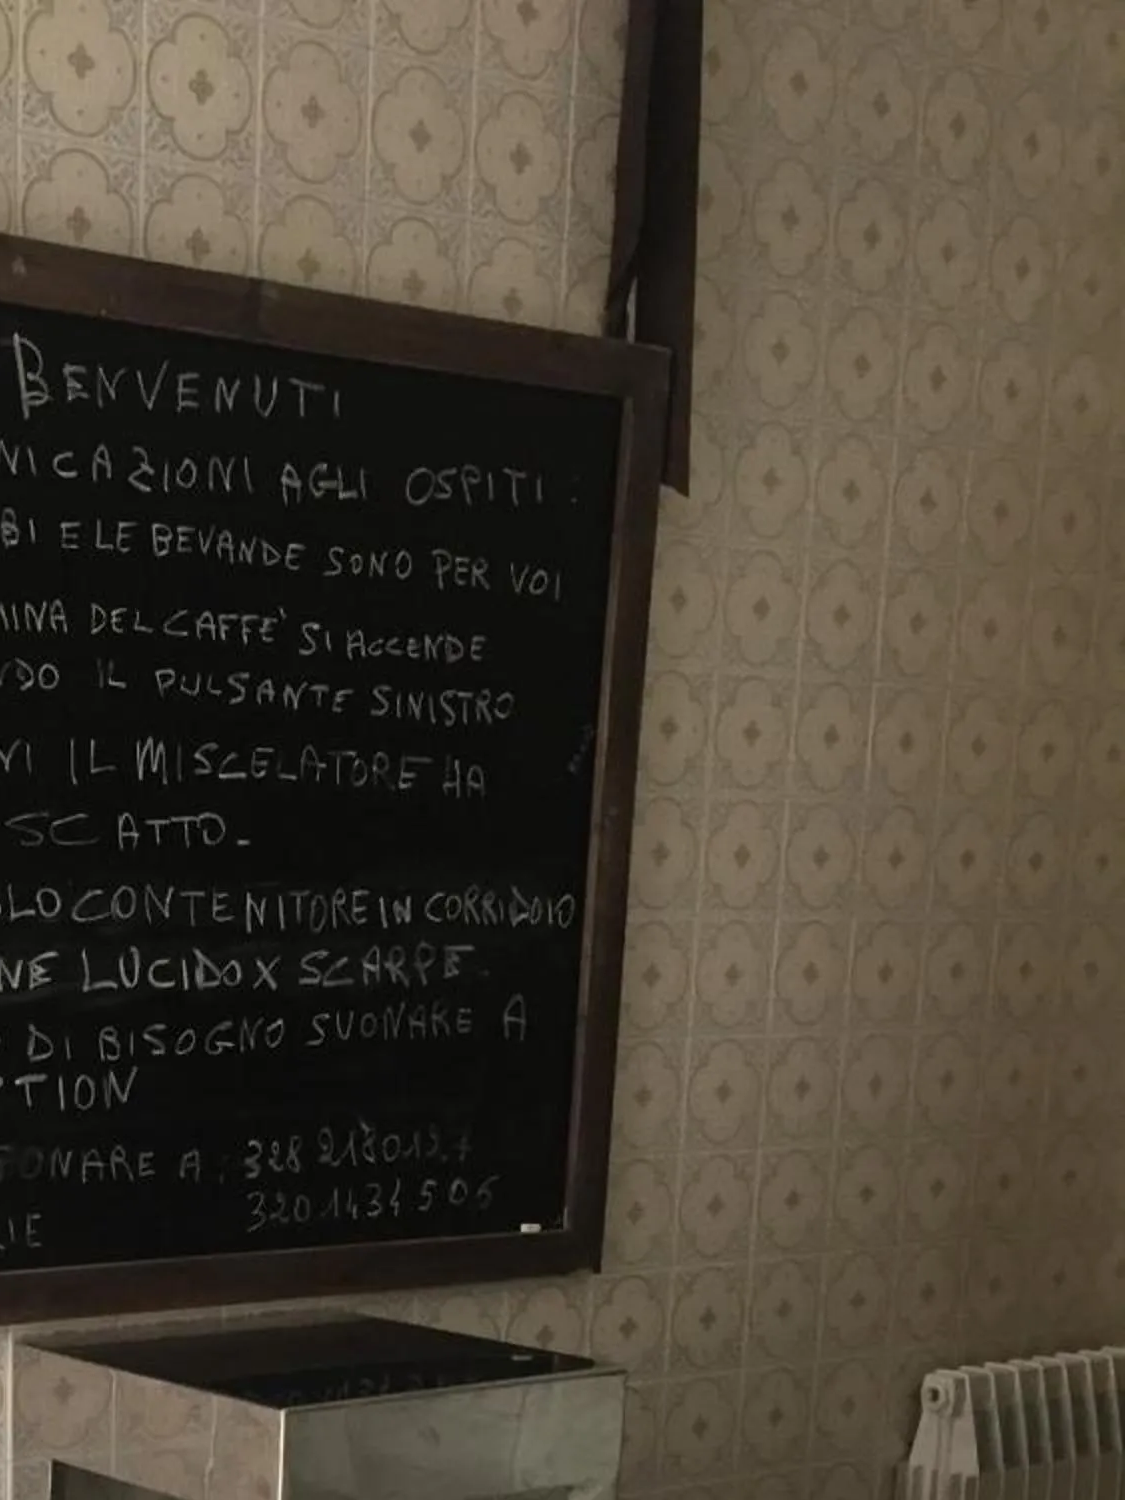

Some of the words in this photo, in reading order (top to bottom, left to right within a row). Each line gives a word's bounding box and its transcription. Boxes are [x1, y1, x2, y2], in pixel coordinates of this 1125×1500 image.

[13, 332, 341, 419] BENVENUTI
[279, 463, 368, 505] AGLI
[151, 522, 307, 571] BEVANDE
[323, 546, 413, 580] SONO
[431, 548, 492, 591] PER
[509, 561, 562, 601] VOI
[89, 602, 154, 635] DEL
[298, 621, 333, 657] SI
[345, 627, 488, 663] ACCENDE
[96, 658, 128, 690] IL
[154, 668, 355, 714] PULSANTE
[370, 684, 516, 727] SINISTRO
[69, 737, 118, 786] IL
[135, 736, 434, 791] MISCELATORE
[442, 754, 487, 799] HA
[71, 883, 371, 935] CONTENITORE
[379, 893, 413, 929] IN
[423, 884, 577, 930] CORRIDOIO
[81, 945, 243, 992] LUCIDO
[253, 955, 282, 990] X
[26, 1023, 73, 1062] DI
[97, 1017, 285, 1062] BISOGNO
[502, 993, 529, 1041] A
